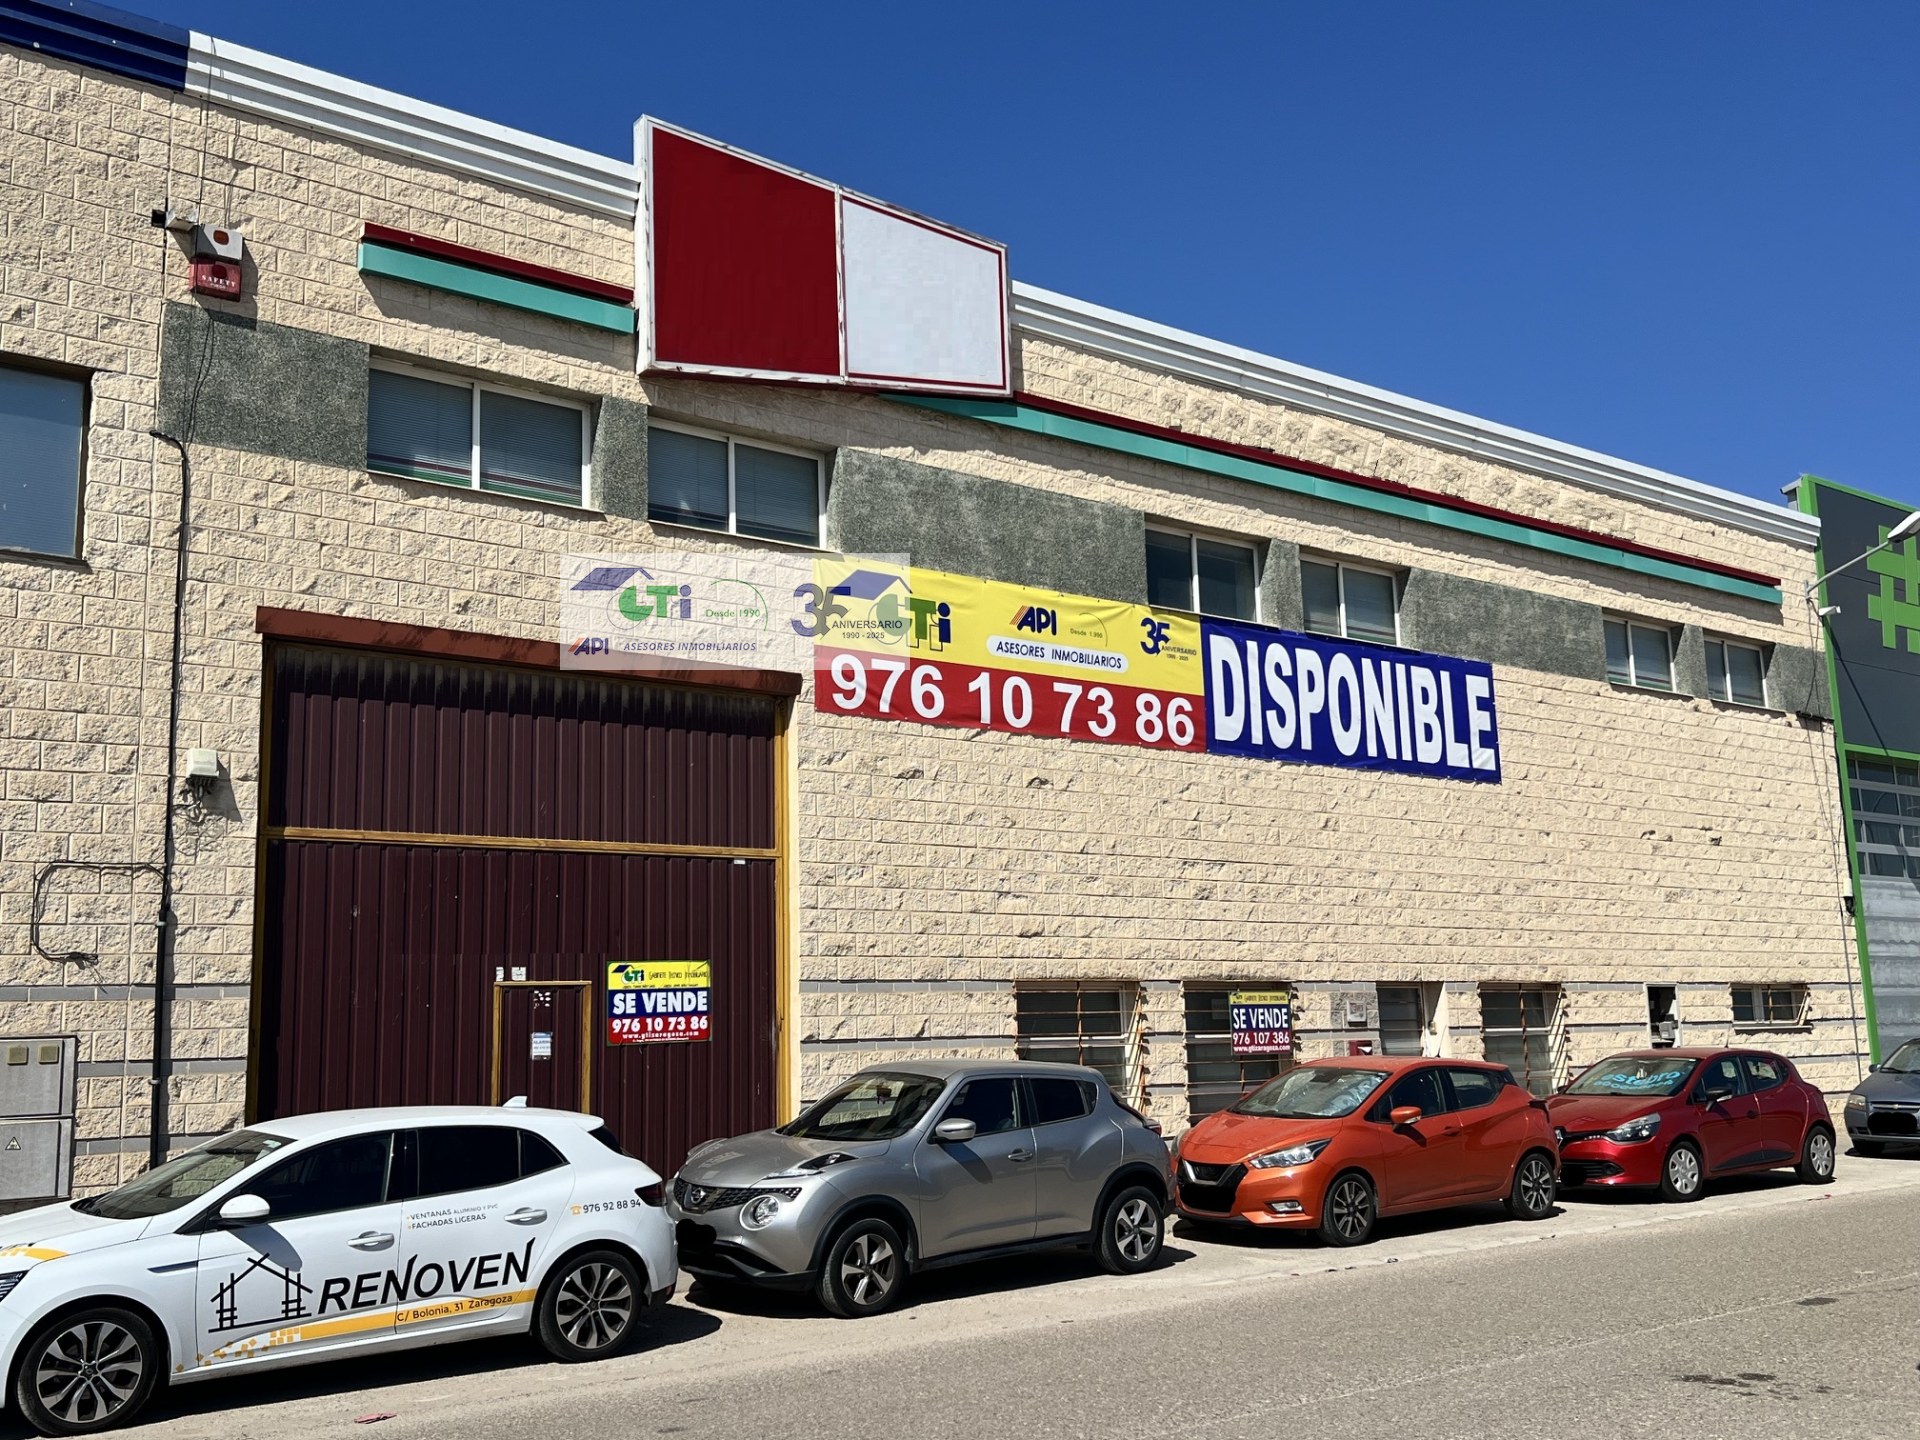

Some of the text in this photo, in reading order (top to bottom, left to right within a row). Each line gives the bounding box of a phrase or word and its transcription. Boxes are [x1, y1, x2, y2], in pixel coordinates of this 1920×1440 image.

[201, 274, 236, 287] SAFETY
[1016, 606, 1057, 636] API
[996, 640, 1122, 669] ASESORES INMOBILIARIOS
[830, 653, 1195, 747] 976 10 73 86
[1208, 633, 1496, 771] DISPONIBLE
[613, 990, 708, 1015] SE VENDE
[612, 1015, 708, 1034] 976 10 73 86
[1232, 1007, 1289, 1030] SE VENDE
[1232, 1031, 1290, 1045] 976 107 386
[410, 1208, 452, 1220] VENTANAS
[453, 1206, 482, 1214] ALUMINIO
[583, 1198, 641, 1214] 976 92 88 94
[412, 1213, 487, 1230] FACHADAS LIGERAS
[318, 1237, 536, 1315] RENOVEN
[397, 1312, 410, 1322] C/
[454, 1302, 464, 1312] 31
[468, 1295, 513, 1309] Zaragoza
